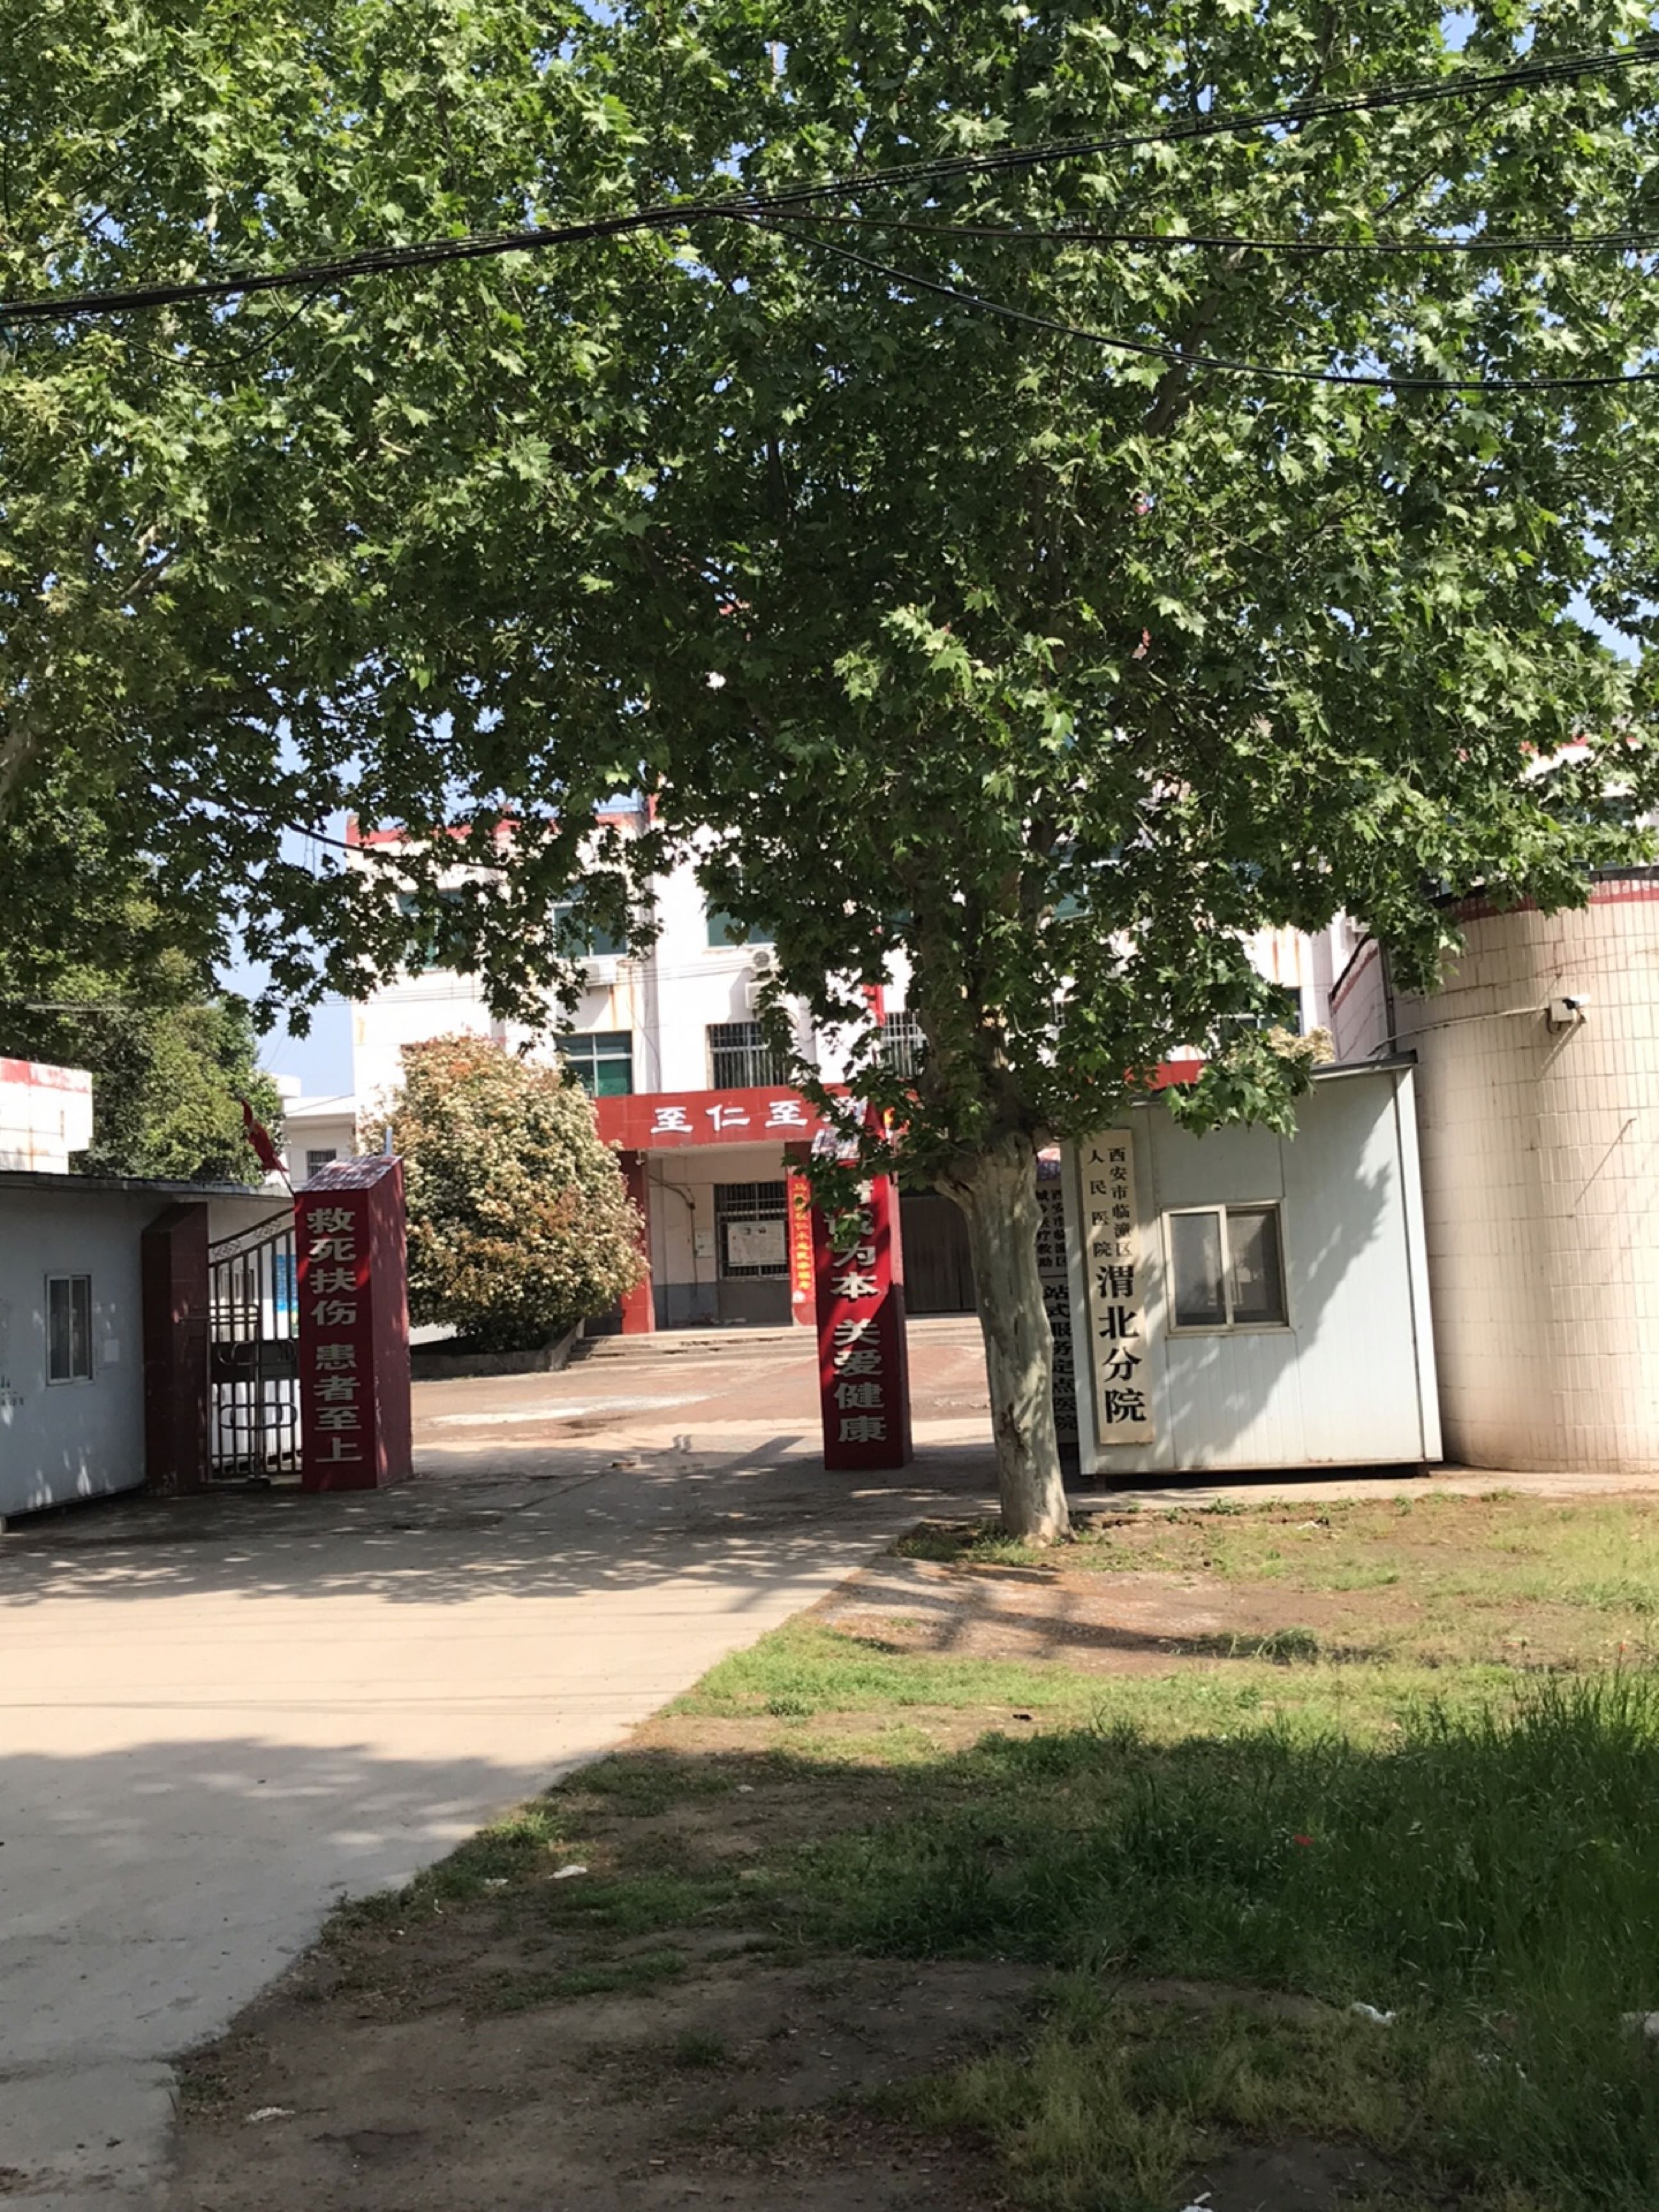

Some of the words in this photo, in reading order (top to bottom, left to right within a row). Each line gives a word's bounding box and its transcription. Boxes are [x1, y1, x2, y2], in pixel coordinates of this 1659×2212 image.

[1088, 1149, 1112, 1258] 人民医院
[1108, 1147, 1133, 1258] 西安市临潼区
[307, 1207, 357, 1326] 救死扶伤
[314, 1343, 363, 1463] 患者至上
[833, 1318, 886, 1443] 关爱健康
[1096, 1264, 1147, 1424] 渭北分院
